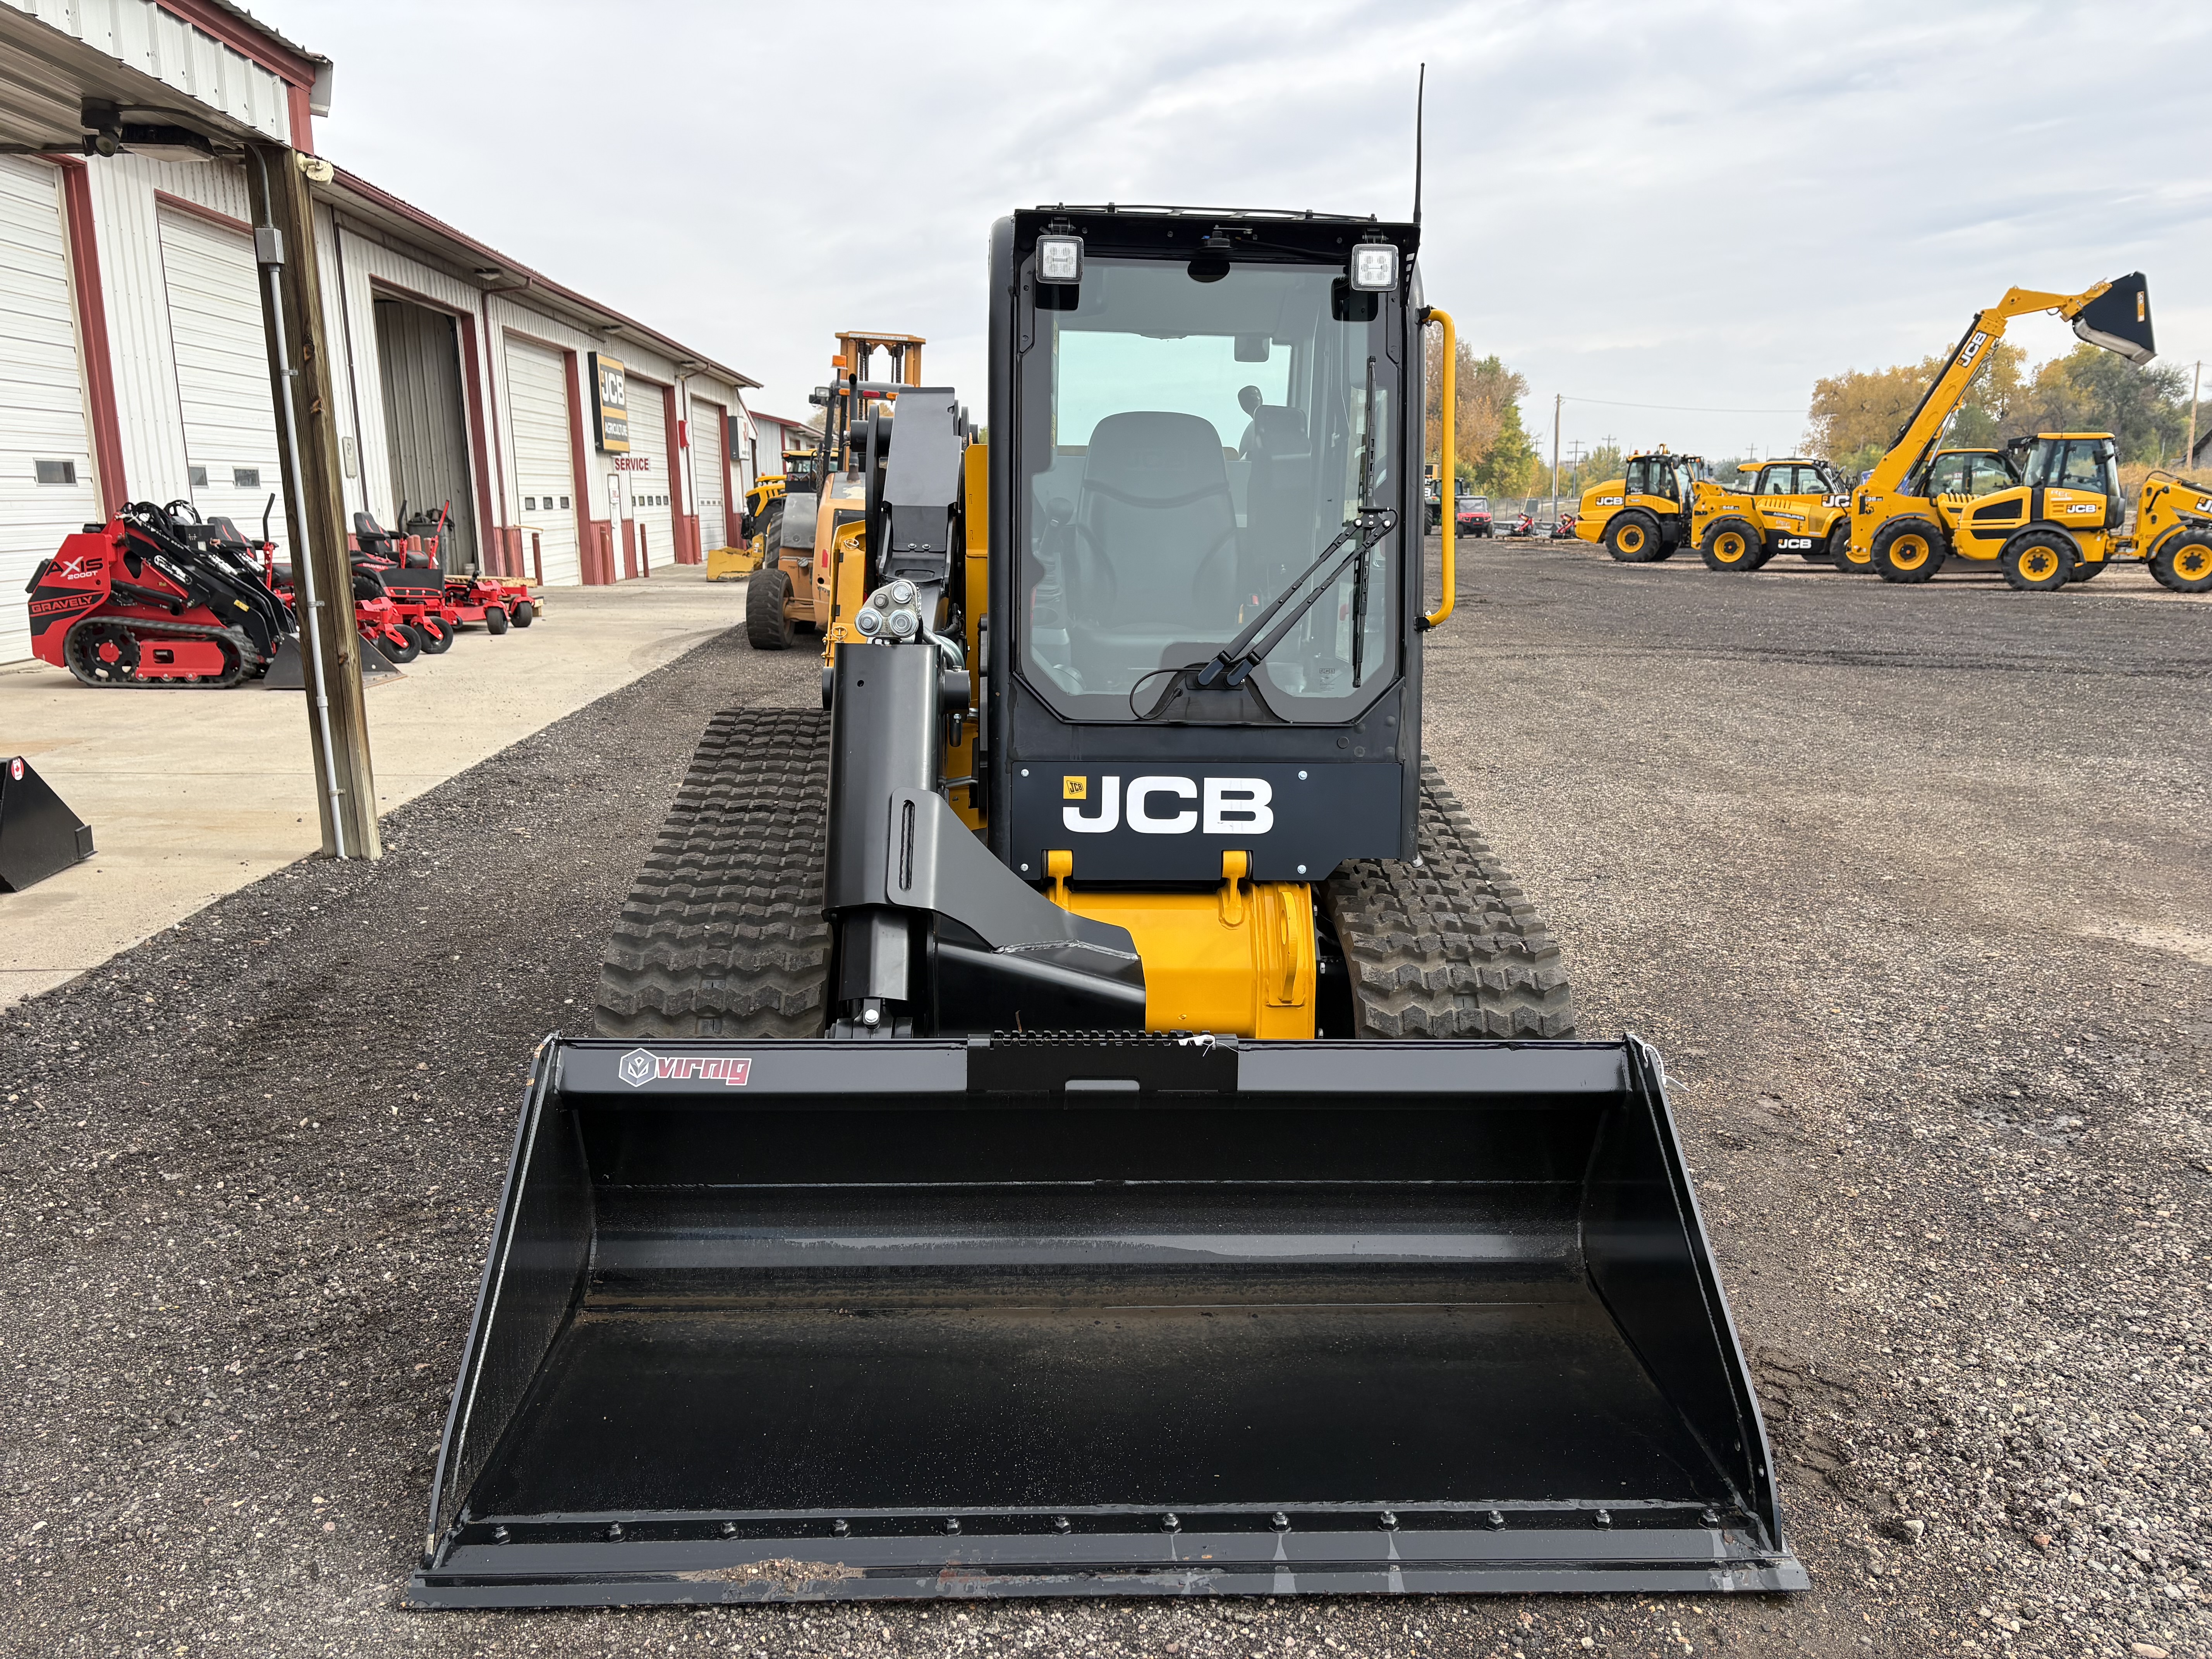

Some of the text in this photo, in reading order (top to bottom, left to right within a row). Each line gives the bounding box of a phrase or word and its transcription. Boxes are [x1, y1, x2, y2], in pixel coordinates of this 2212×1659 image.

[1961, 331, 1987, 367] JCB
[601, 371, 625, 405] JCB
[615, 458, 649, 471] SERVICE
[1596, 497, 1623, 505] JCB
[1822, 495, 1851, 507] JC
[2067, 505, 2096, 513] JCB
[1778, 539, 1812, 549] JCB
[45, 556, 103, 577] AXIS
[67, 570, 98, 580] 2000T
[31, 596, 93, 613] GRAVELY
[1070, 782, 1082, 793] JCB
[1063, 776, 1274, 834] JCB
